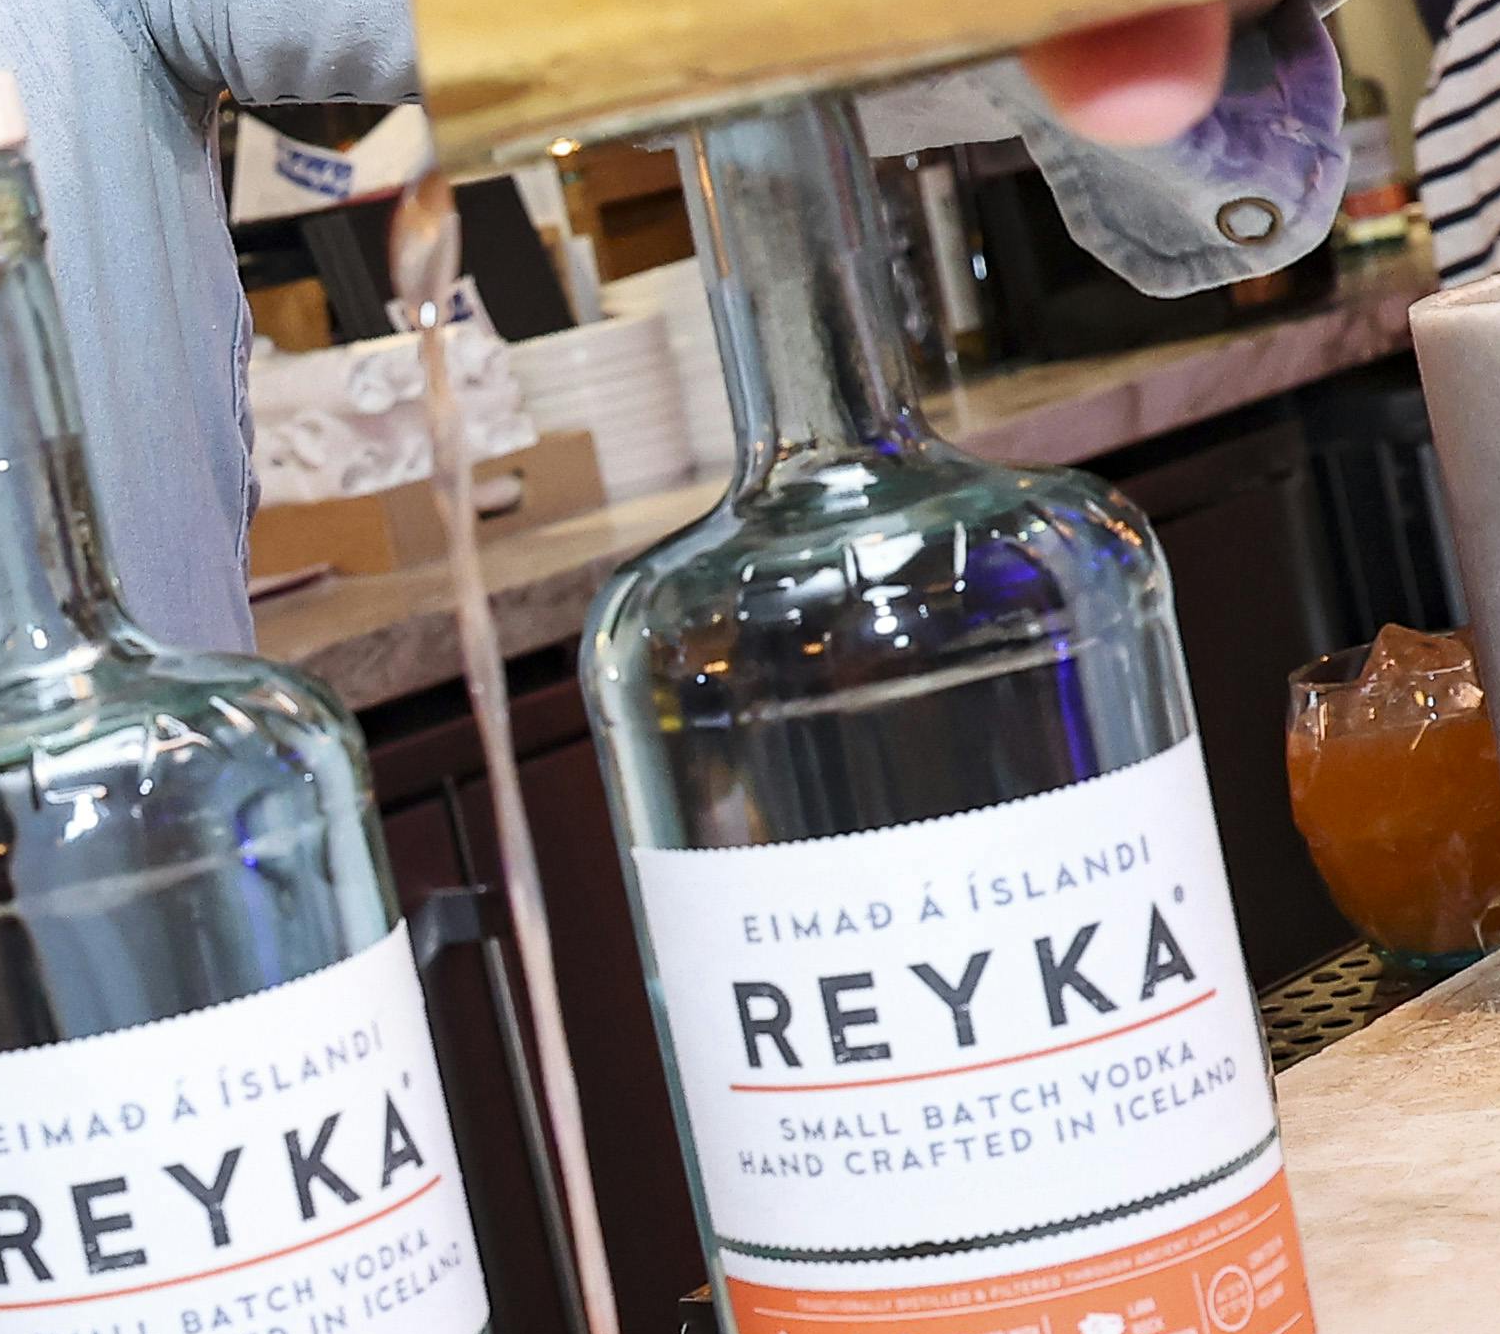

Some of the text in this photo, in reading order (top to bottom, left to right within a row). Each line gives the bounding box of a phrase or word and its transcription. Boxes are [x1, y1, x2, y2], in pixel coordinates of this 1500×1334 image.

[920, 881, 944, 922] Á
[968, 834, 1151, 911] ÍSLANDI
[732, 902, 1196, 1068] REYKA
[172, 1079, 198, 1122] Á
[218, 1020, 384, 1107] ÍSLANDI
[739, 1056, 1238, 1178] HAND CRAFTED IN ICELAND
[780, 1041, 1197, 1142] SMALL BATCH VODKA
[331, 1229, 430, 1287] VODKA
